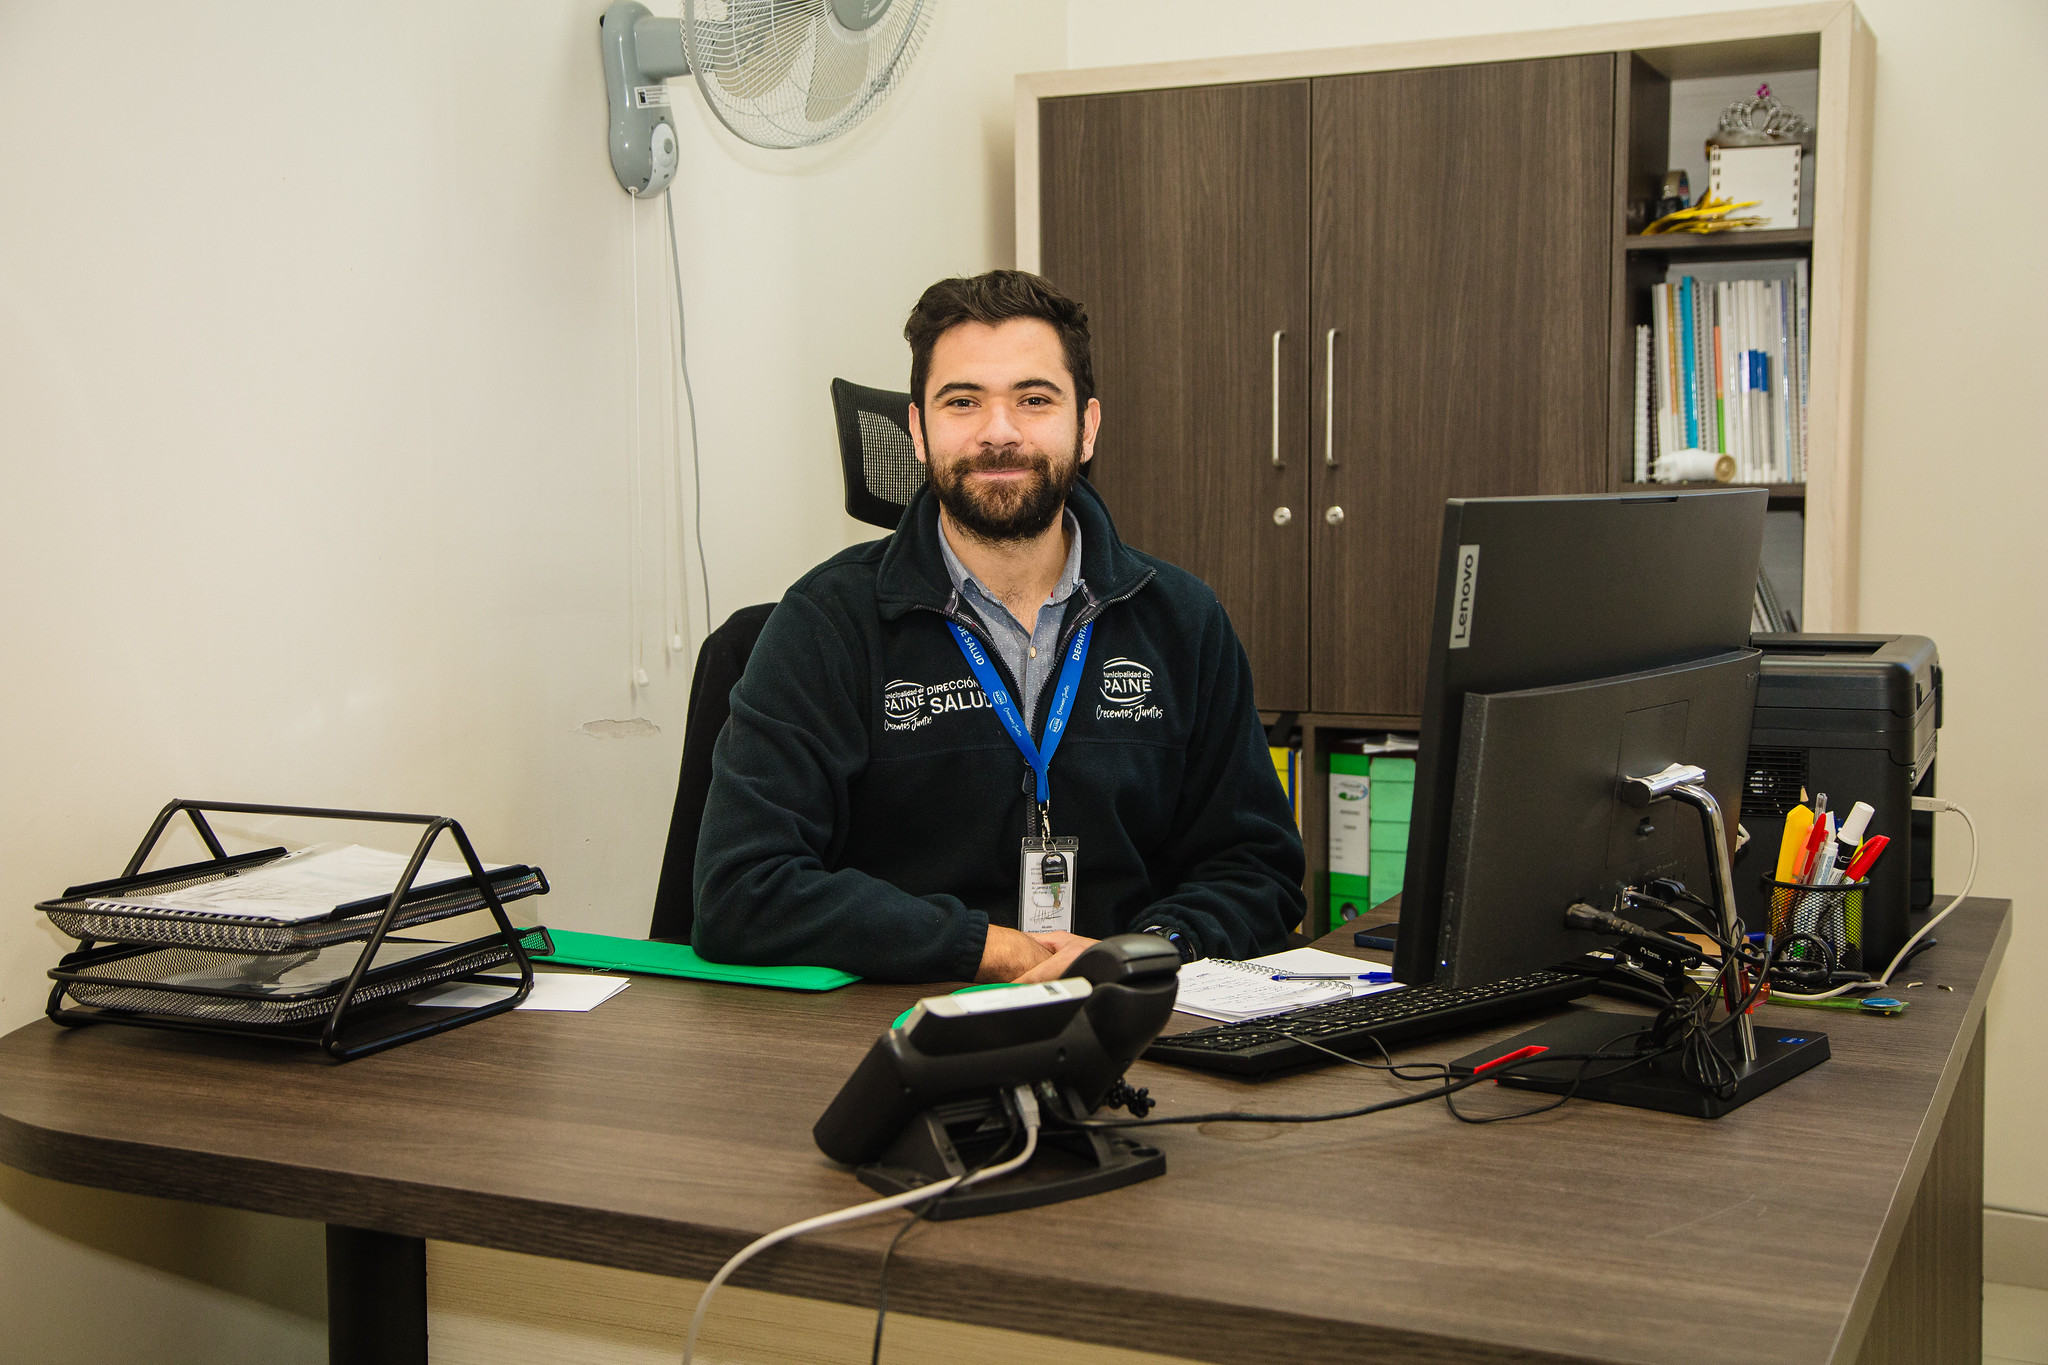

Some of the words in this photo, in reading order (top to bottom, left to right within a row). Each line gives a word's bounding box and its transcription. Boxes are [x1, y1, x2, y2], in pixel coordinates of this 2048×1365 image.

[1455, 554, 1474, 639] Lenovo
[964, 636, 985, 666] SALUD
[885, 688, 917, 699] unicipalidad
[927, 676, 979, 696] DIRECCIÓN
[1104, 679, 1152, 693] PAINE
[885, 694, 925, 711] PAINE
[1096, 704, 1133, 720] Crecemos
[1135, 704, 1163, 721] Juntos
